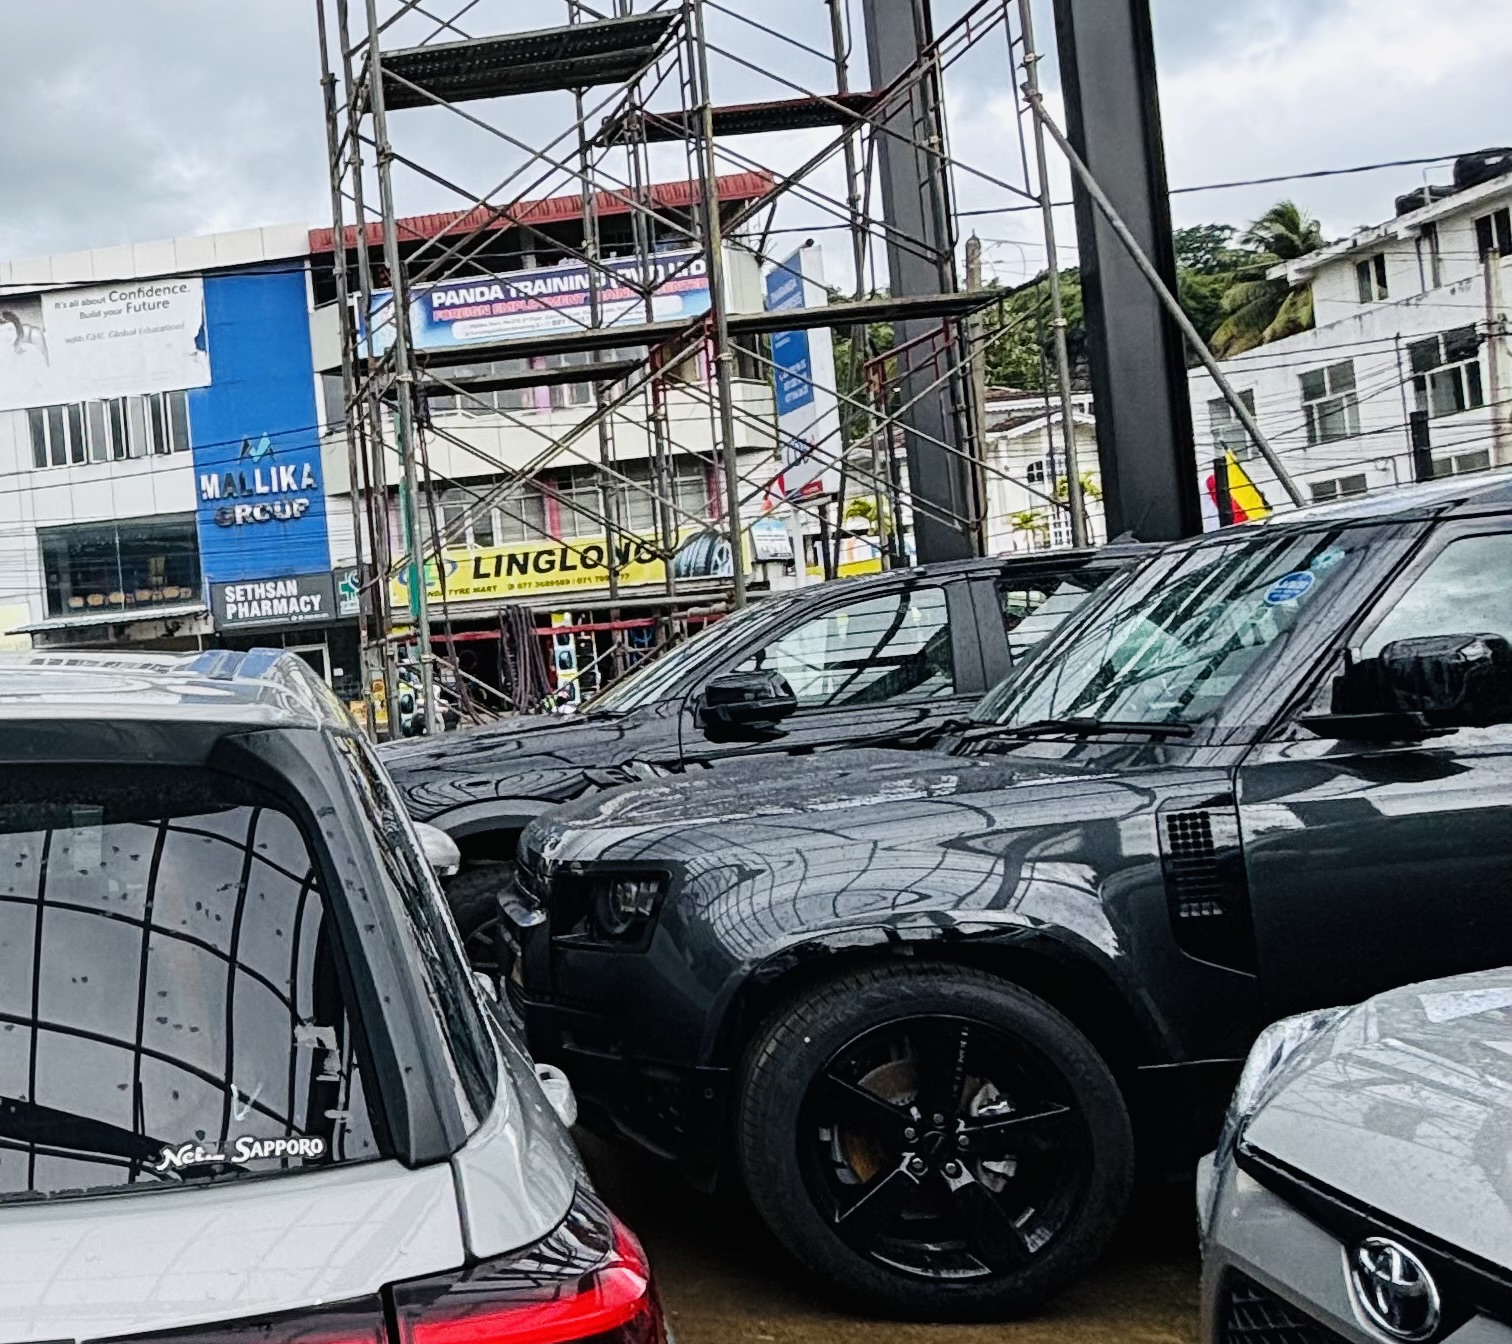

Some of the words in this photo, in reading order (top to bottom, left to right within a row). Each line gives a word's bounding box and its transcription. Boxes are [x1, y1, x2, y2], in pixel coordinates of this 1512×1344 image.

[69, 300, 80, 308] all
[81, 296, 106, 307] about
[431, 285, 505, 307] PANDA
[79, 310, 101, 320] Build
[103, 308, 123, 319] your
[126, 297, 170, 314] Future
[200, 463, 318, 500] MALLIKA
[215, 498, 310, 527] GROUP
[224, 579, 298, 602] SETHSAN
[226, 594, 321, 619] PHARMACY
[231, 1136, 324, 1163] SAPPORO
